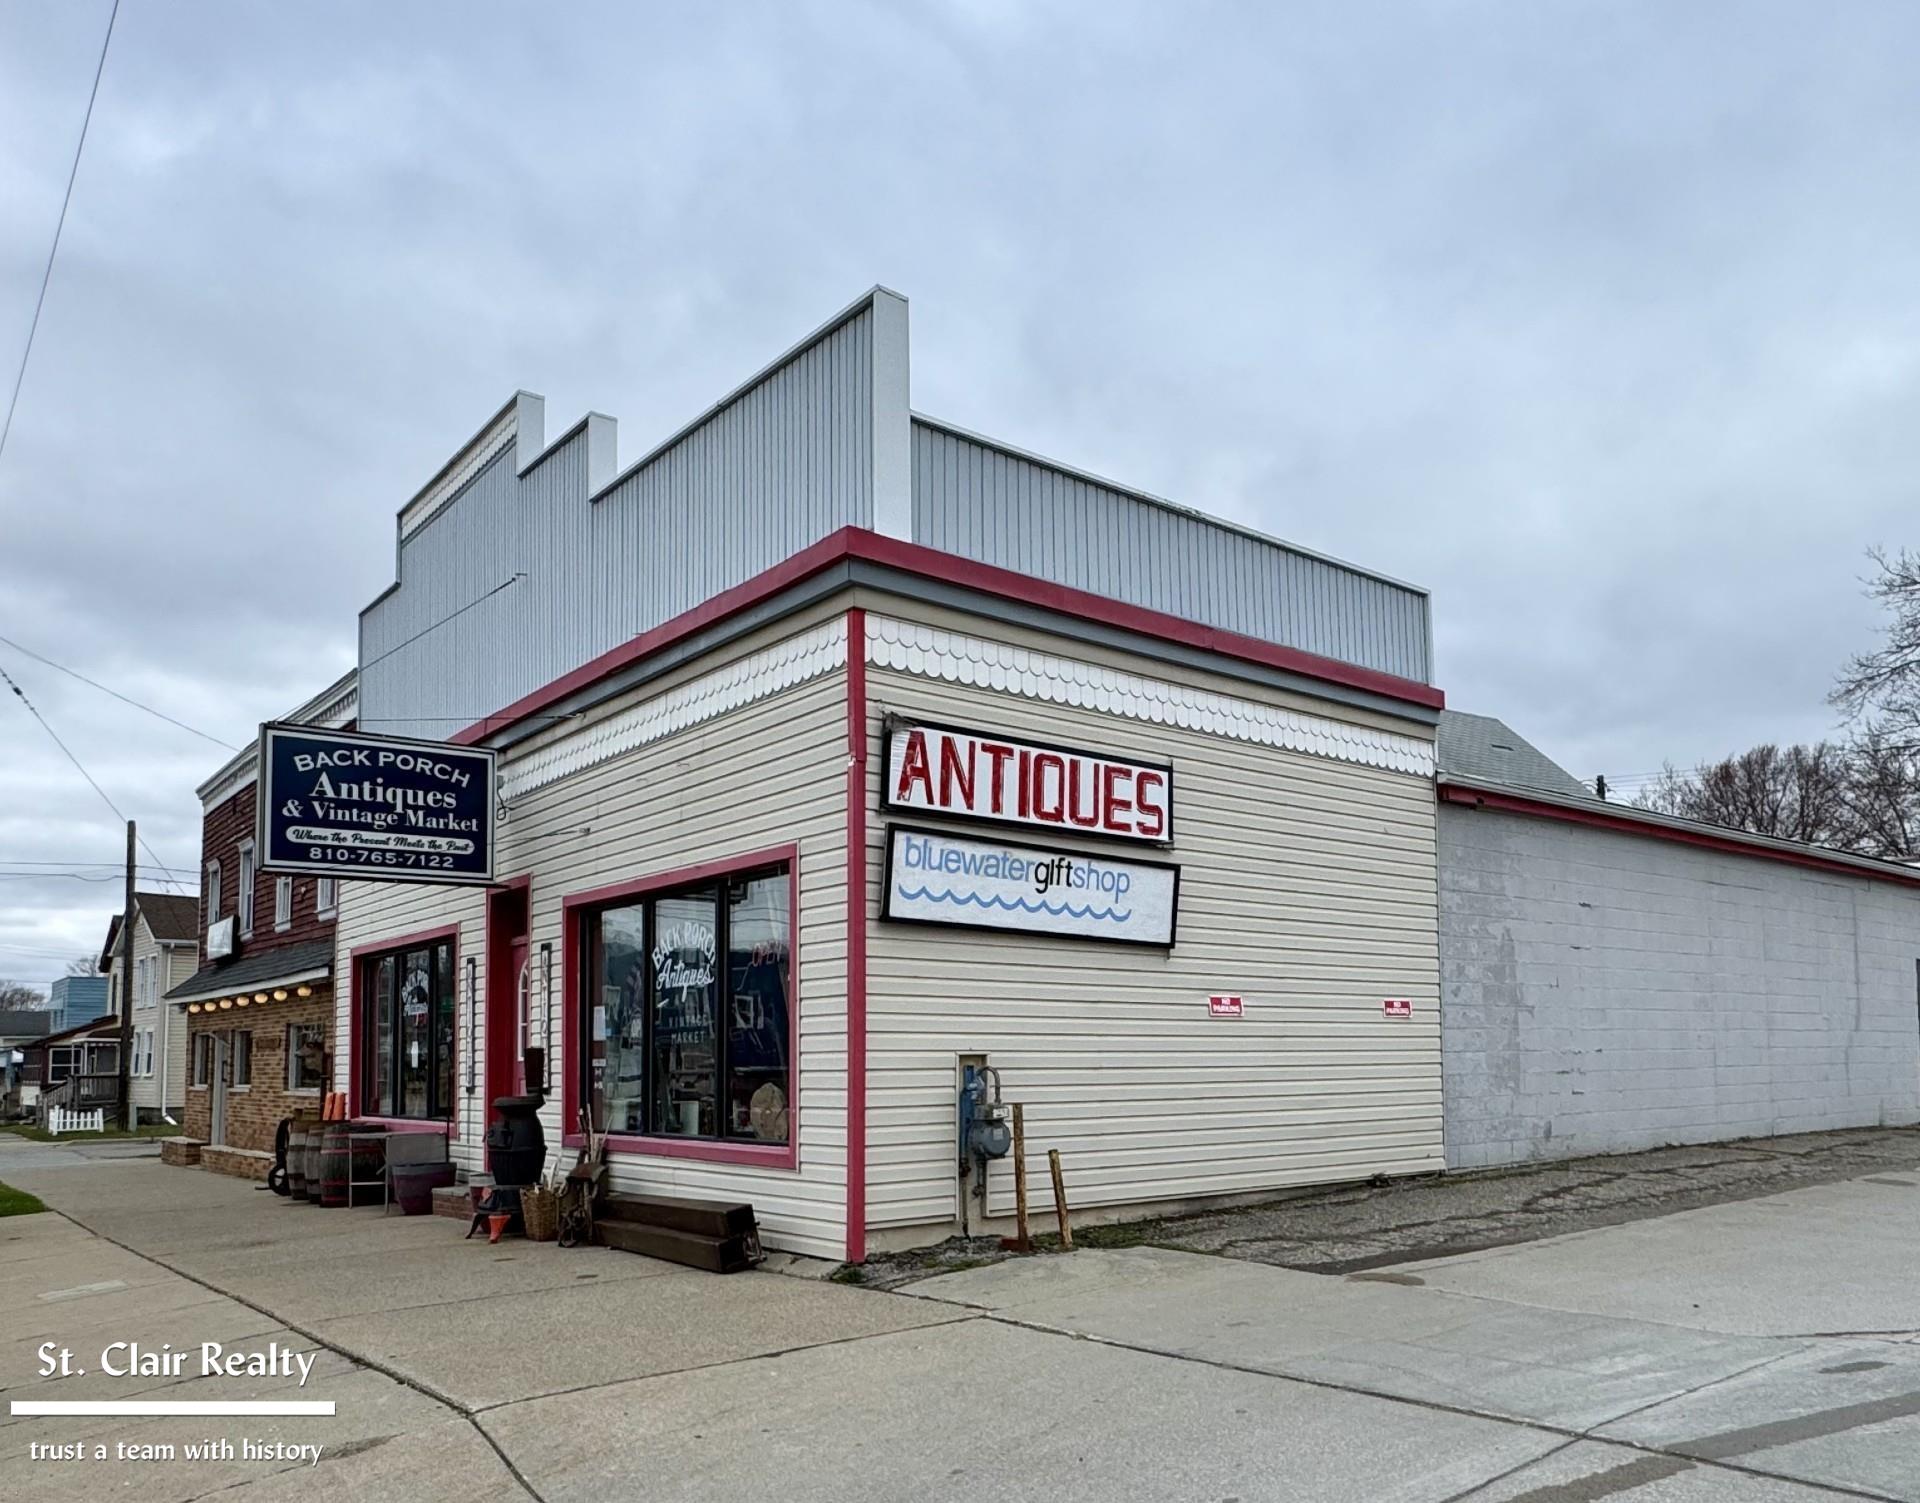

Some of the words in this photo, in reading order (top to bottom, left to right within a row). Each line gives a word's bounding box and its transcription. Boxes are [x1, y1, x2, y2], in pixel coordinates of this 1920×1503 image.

[294, 750, 372, 772] BACK
[378, 752, 471, 788] PORCH
[897, 730, 1163, 836] ANTIQUES
[309, 771, 457, 813] Antiques
[282, 799, 303, 818] &
[311, 800, 399, 829] Vintage
[405, 810, 479, 832] Market
[292, 829, 329, 842] Where
[331, 832, 348, 843] the
[351, 833, 392, 846] Present
[393, 836, 425, 849] Meets
[427, 839, 442, 850] the
[309, 847, 454, 868] 810-765-7122
[905, 836, 1131, 904] bluewatergiftshop
[652, 924, 681, 970] BACK
[684, 921, 716, 966] PORCH
[656, 958, 714, 1002] Antiques
[671, 1030, 706, 1044] MARKET
